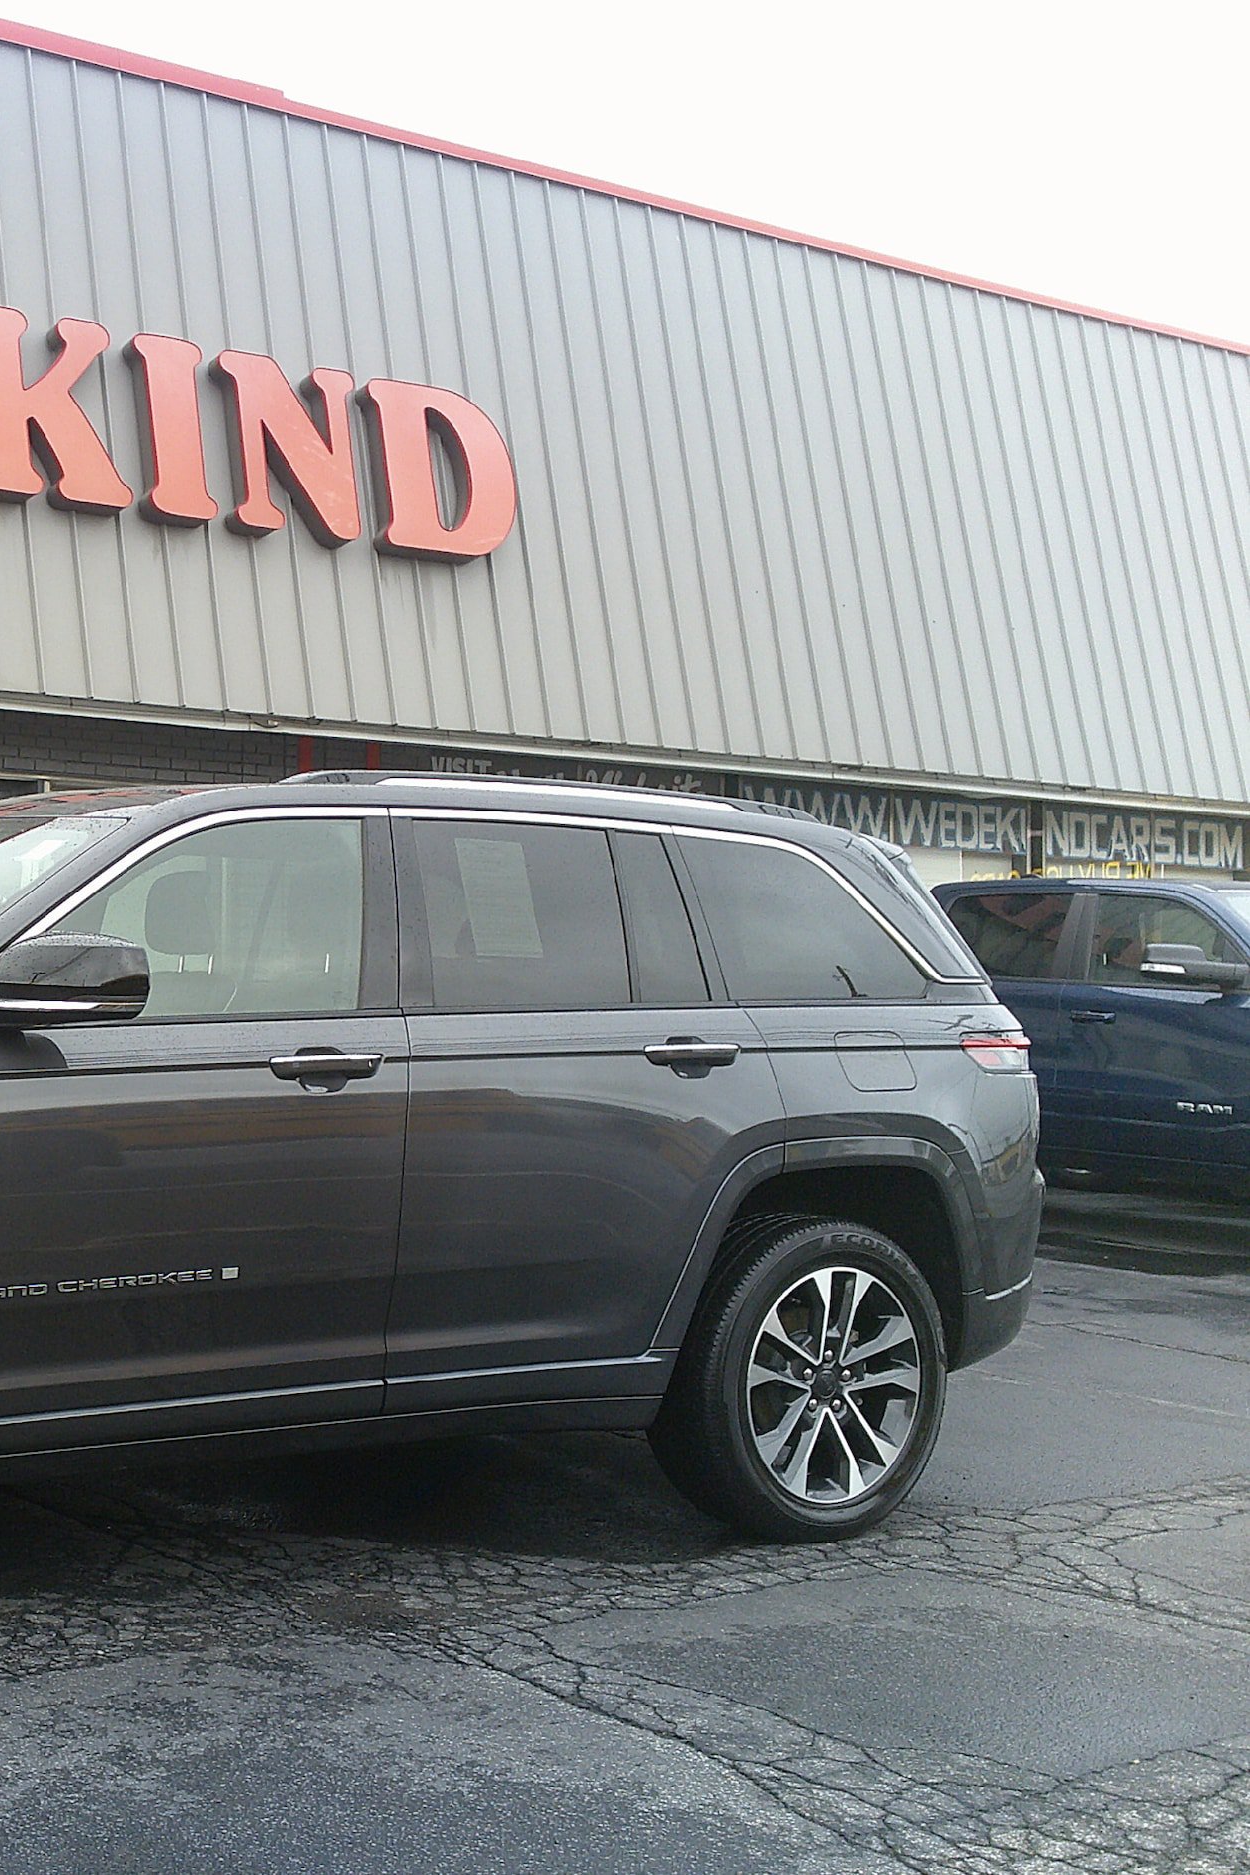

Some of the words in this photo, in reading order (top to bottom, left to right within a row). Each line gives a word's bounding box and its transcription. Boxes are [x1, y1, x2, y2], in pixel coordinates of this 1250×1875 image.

[430, 755, 493, 774] VISIT
[1176, 1101, 1233, 1116] RAM
[56, 1268, 213, 1293] CHEROKEE
